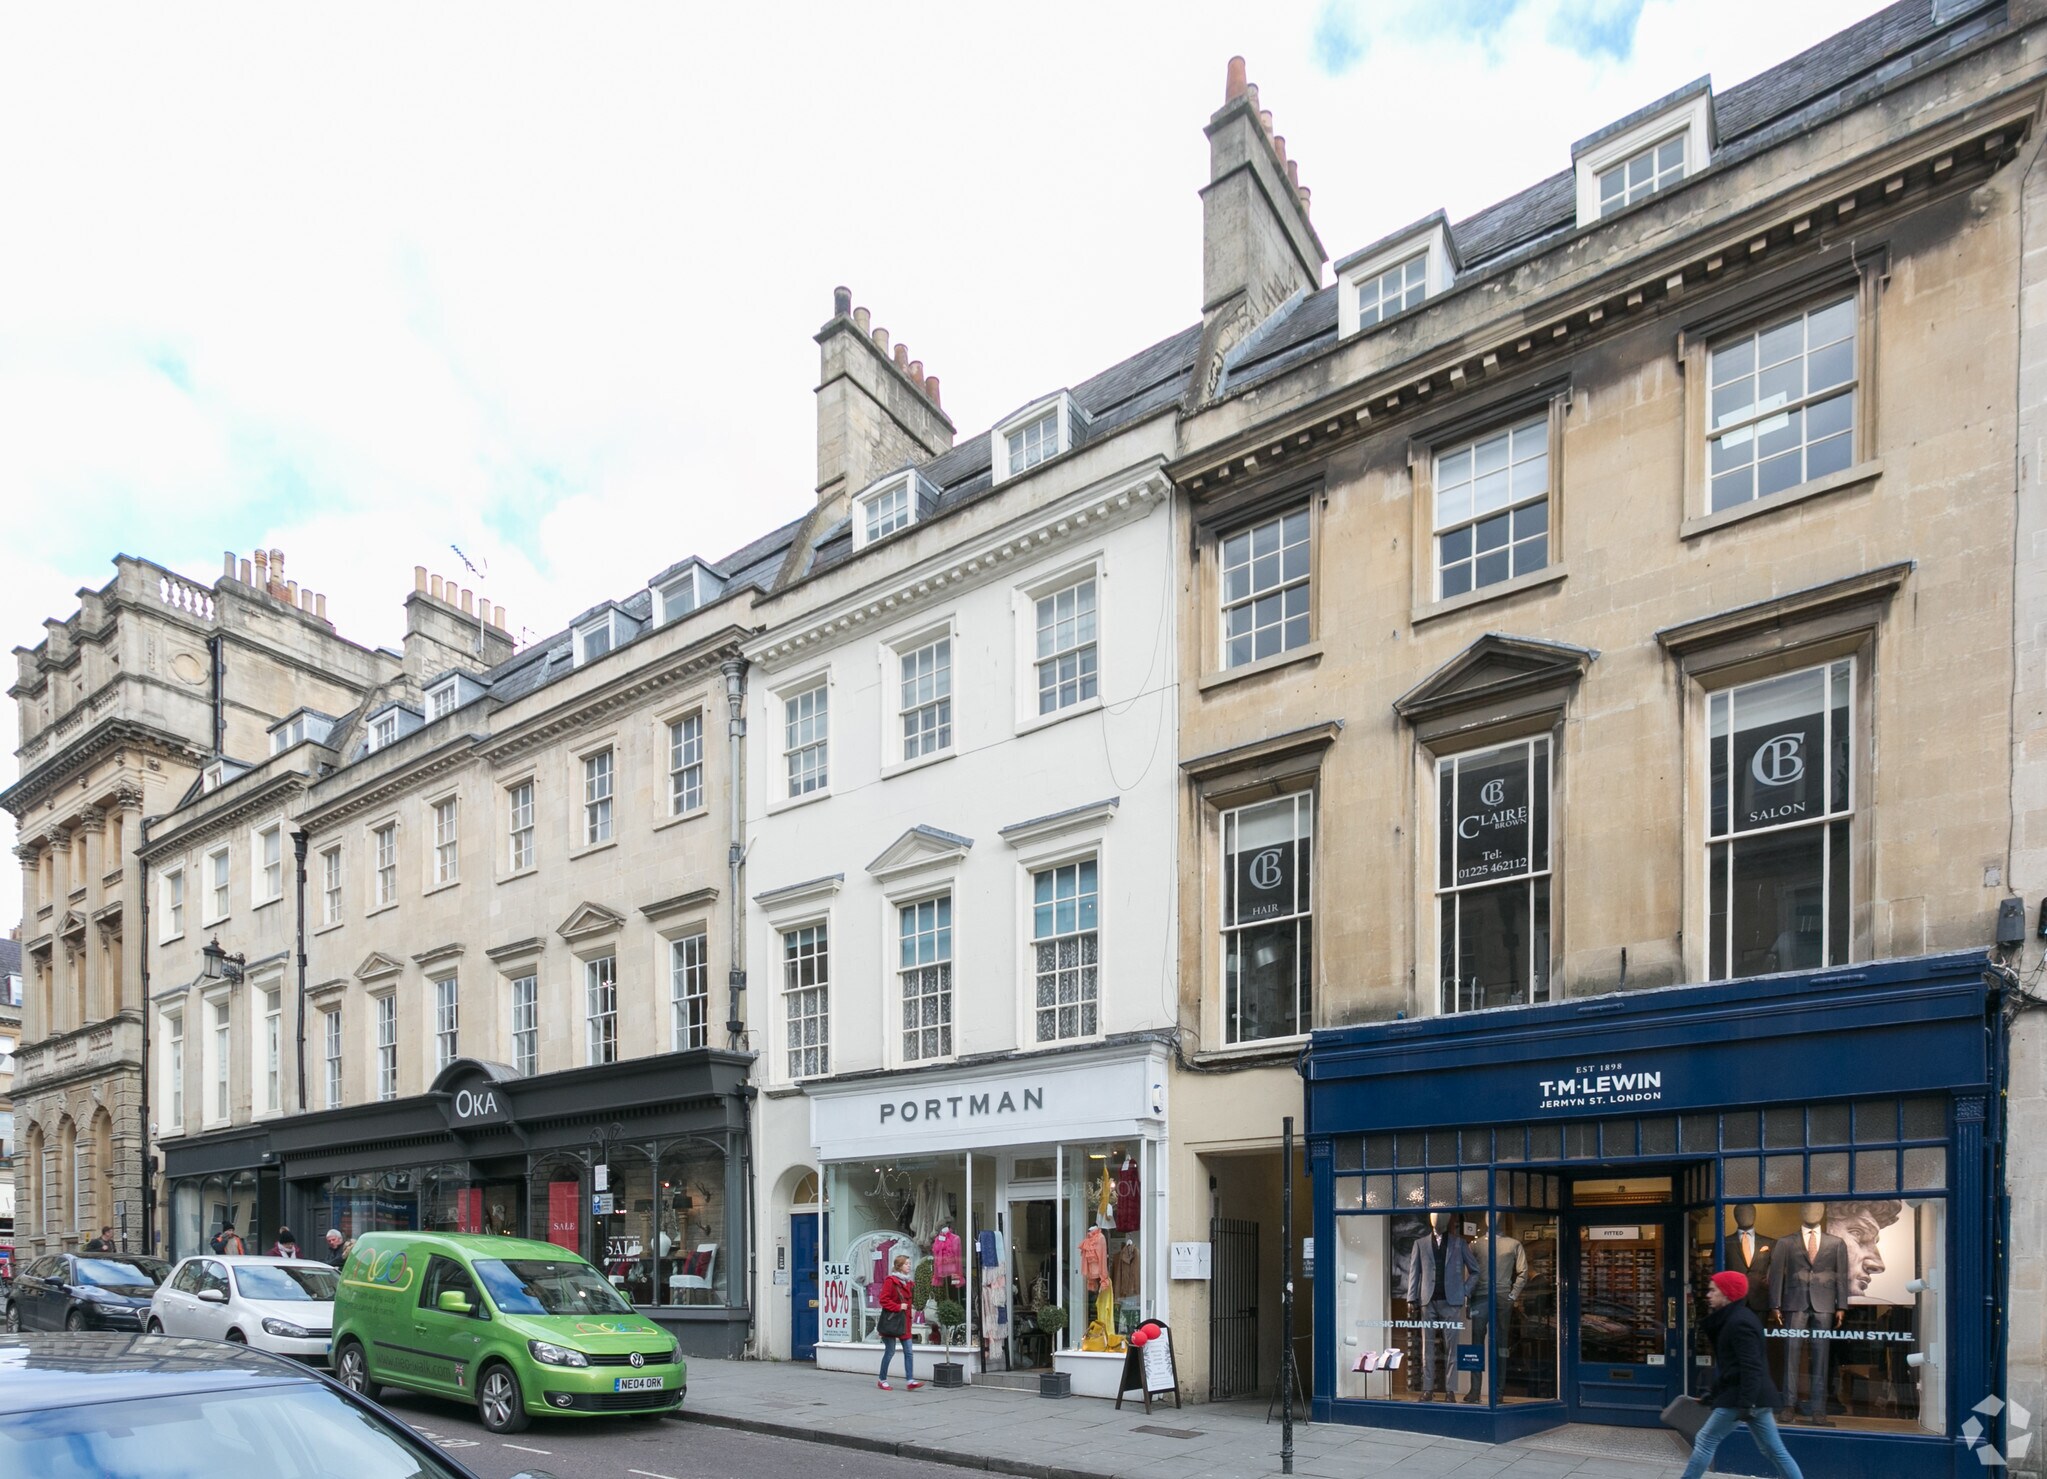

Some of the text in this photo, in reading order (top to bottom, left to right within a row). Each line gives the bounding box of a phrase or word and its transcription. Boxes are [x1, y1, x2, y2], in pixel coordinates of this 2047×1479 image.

[1749, 801, 1806, 822] SALON
[1458, 805, 1528, 839] CLAIRE
[1494, 817, 1528, 830] BROWN
[1482, 849, 1502, 861] Tel:
[1458, 857, 1527, 879] 01225 462112
[1252, 903, 1279, 916] HAIR
[1575, 1062, 1623, 1074] EST 1898
[456, 1089, 498, 1118] OKA
[880, 1086, 1043, 1125] PORTMAN
[1540, 1091, 1661, 1109] JERMYN ST. LONDON
[553, 1222, 575, 1231] SALE
[606, 1240, 640, 1255] SALE
[824, 1264, 850, 1275] SALE
[824, 1280, 850, 1314] 50%
[826, 1317, 847, 1329] OFF
[1395, 1320, 1431, 1329] ITALIAN
[1432, 1321, 1466, 1330] STYLE.
[1763, 1328, 1916, 1341] LASSIC ITALIAN STYLE.
